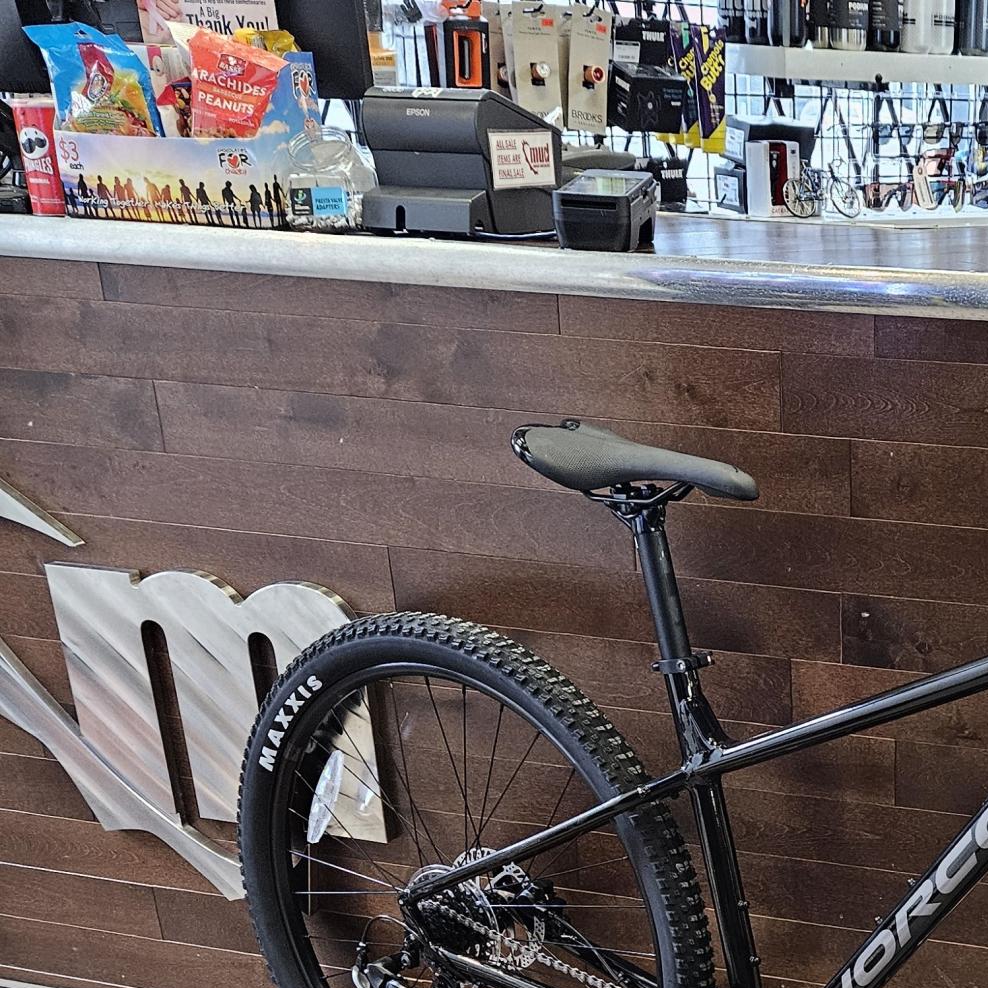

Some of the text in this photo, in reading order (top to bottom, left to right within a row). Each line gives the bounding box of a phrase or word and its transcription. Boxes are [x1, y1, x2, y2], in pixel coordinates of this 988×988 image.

[199, 6, 221, 19] A Big
[185, 13, 270, 36] Thank You!
[701, 39, 724, 75] Chamois
[192, 68, 268, 97] ARACHIDES
[197, 91, 255, 115] PEANUTS
[406, 108, 431, 117] EPSON
[571, 109, 603, 124] BROOKS
[58, 136, 79, 164] $3
[496, 138, 517, 150] ALL SALE
[69, 163, 85, 172] each
[259, 675, 323, 772] MAXXIS
